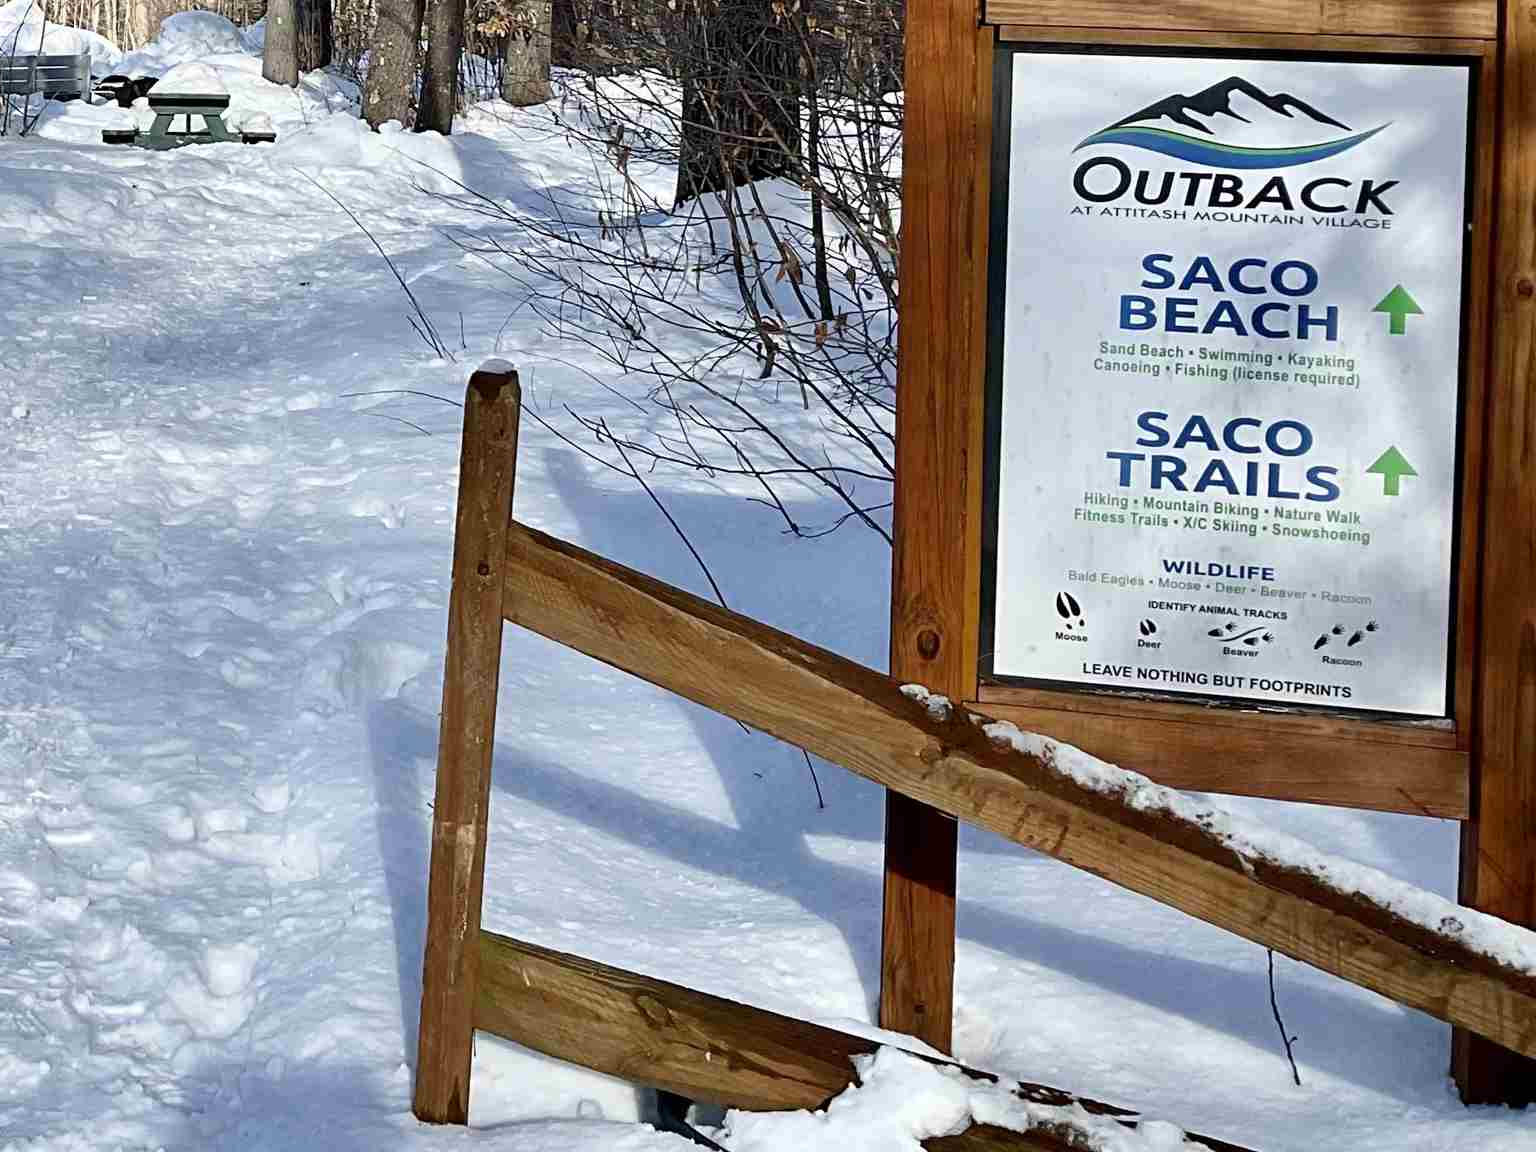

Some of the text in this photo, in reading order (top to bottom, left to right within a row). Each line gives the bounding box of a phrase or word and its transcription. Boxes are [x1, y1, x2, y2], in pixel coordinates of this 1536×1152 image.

[1073, 156, 1400, 215] OUTBACK
[1070, 205, 1392, 230] AT ATTITASH MOUNTAIN VILLAGE
[1140, 253, 1319, 297] SACO
[1119, 294, 1339, 342] BEACH
[1099, 342, 1355, 370] Sand Beach Swimming Kayaking
[1093, 358, 1361, 389] Canoeing Fishing (license required)
[1135, 411, 1314, 457] SACO
[1106, 451, 1341, 502] TRAILS
[1084, 491, 1361, 525] Hiking Mountain Biking Nature Walk
[1074, 508, 1371, 545] Fitness Trails X/C Skiing Snowshoeing
[1162, 559, 1276, 582] WILDLIFE
[1068, 569, 1373, 605] Bald Eagles Moose Deer Beaver Racoon
[1147, 600, 1288, 620] IDENTIFY ANIMAL TRACKS
[1055, 631, 1088, 642] Moose
[1137, 639, 1162, 649] Deer
[1223, 646, 1259, 657] Beaver
[1321, 655, 1363, 667] Racoon
[1082, 662, 1353, 698] LEAVE NOTHING BUT FOOTPRINTS
